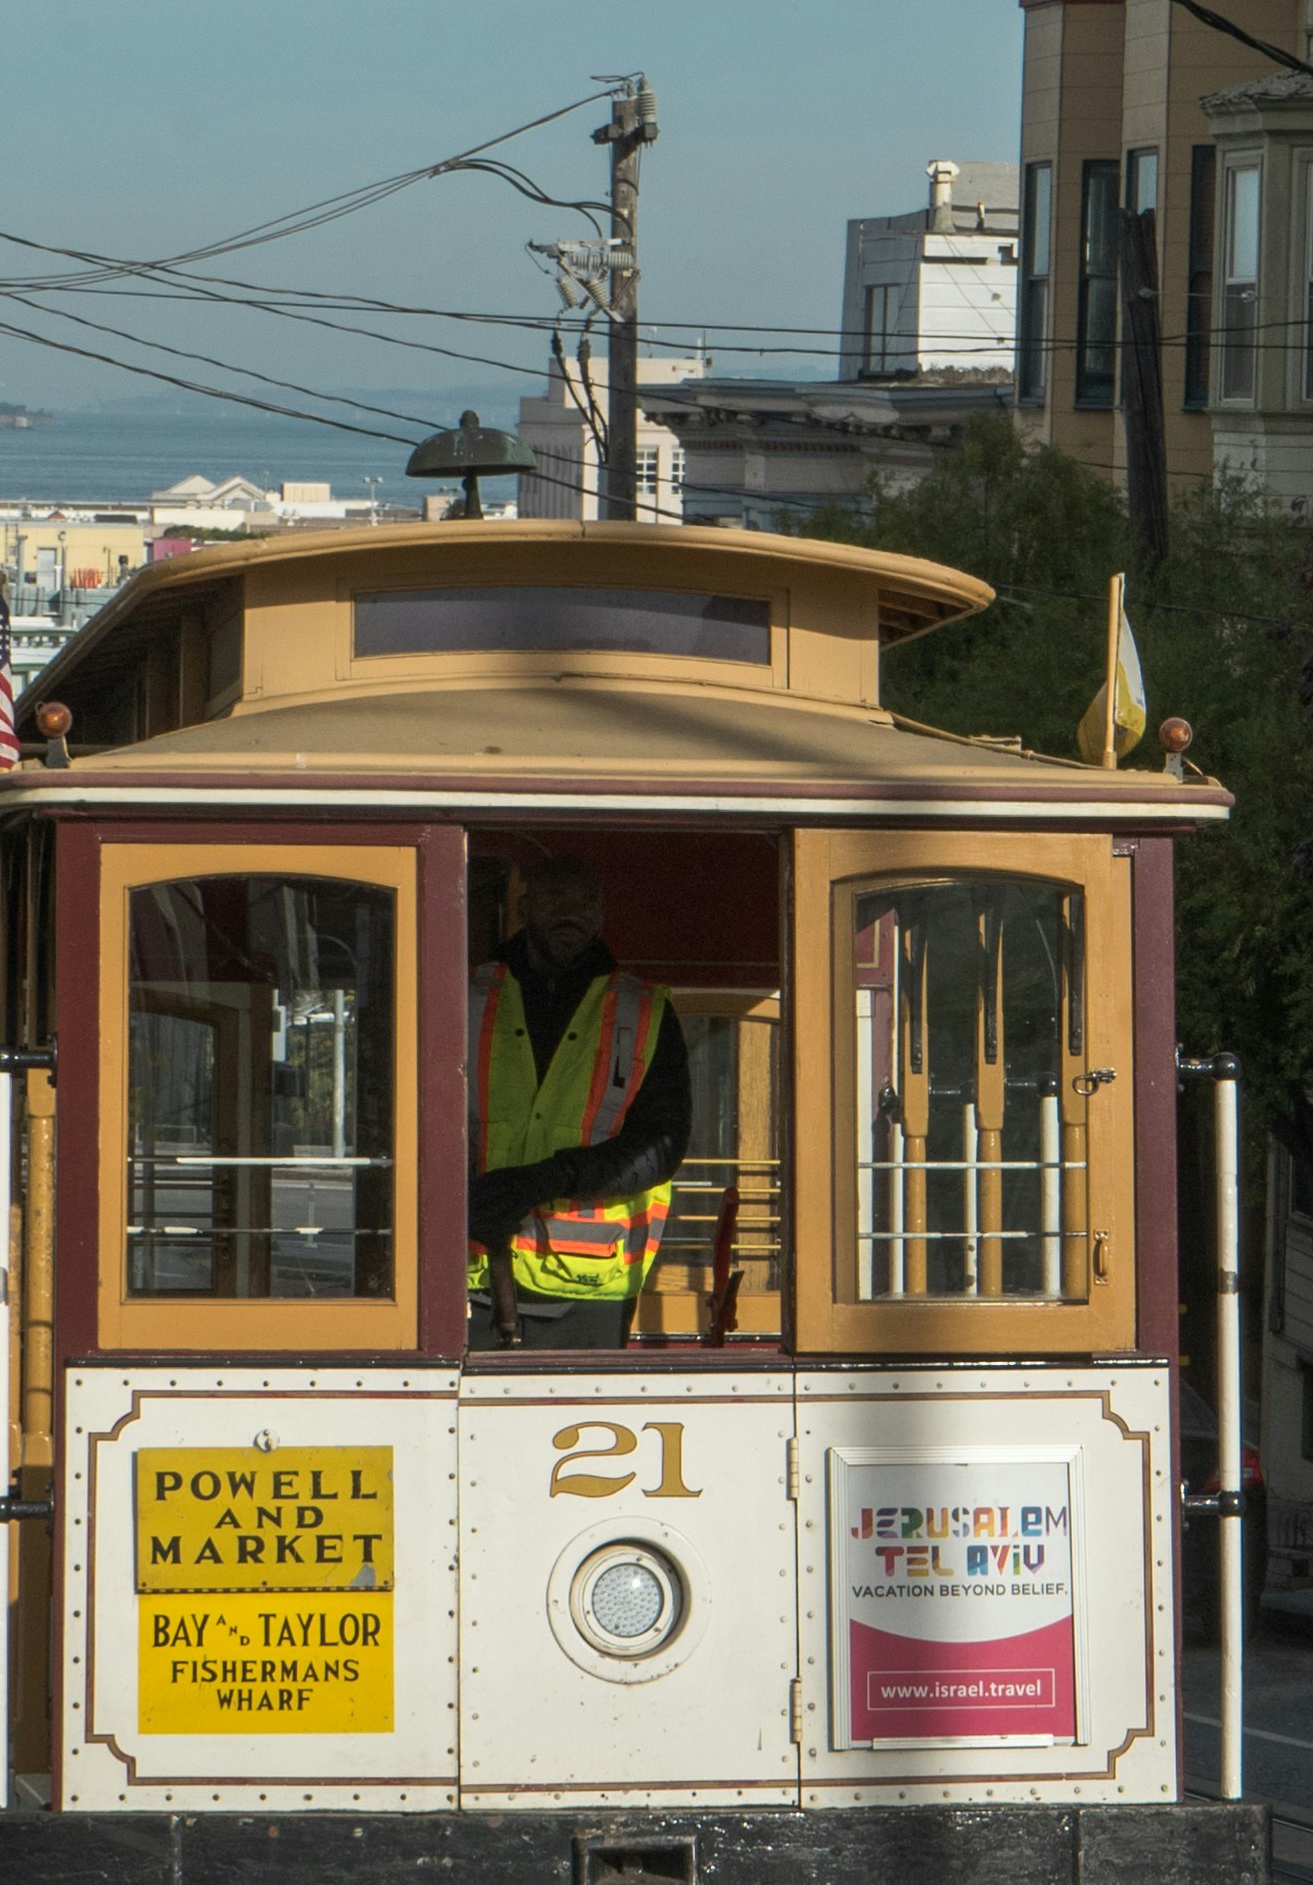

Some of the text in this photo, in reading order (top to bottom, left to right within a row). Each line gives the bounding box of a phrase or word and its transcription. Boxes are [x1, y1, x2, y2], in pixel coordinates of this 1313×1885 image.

[549, 1421, 704, 1499] 21
[154, 1470, 378, 1501] POWELL
[214, 1506, 325, 1529] AND
[150, 1534, 383, 1565] MARKET
[874, 1545, 955, 1578] TEL
[851, 1582, 1068, 1598] VACATION BEYOND BELIEF.
[153, 1614, 210, 1648] BAY
[258, 1613, 382, 1647] TAYLOR
[171, 1659, 360, 1684] FISHERMANS
[216, 1689, 313, 1711] WHARF
[880, 1679, 1042, 1699] www.israel.travel
